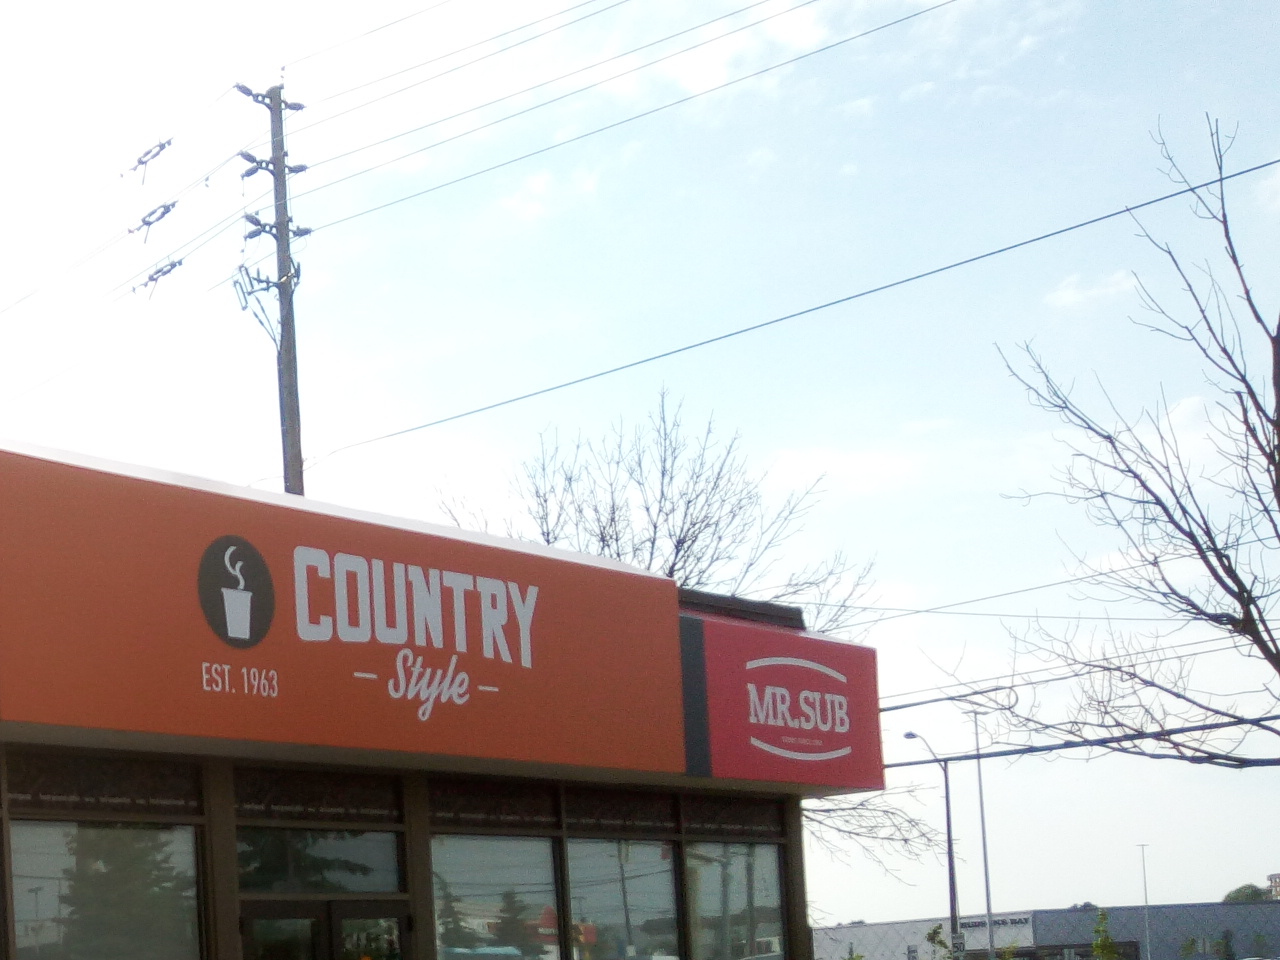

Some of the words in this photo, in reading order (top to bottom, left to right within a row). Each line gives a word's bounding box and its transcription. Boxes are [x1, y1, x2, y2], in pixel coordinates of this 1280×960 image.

[293, 545, 540, 670] COUNTRY
[201, 661, 236, 694] EST.
[241, 666, 279, 698] 1963
[387, 647, 471, 722] Style
[746, 683, 850, 733] MR.SUB
[954, 942, 965, 952] 50
